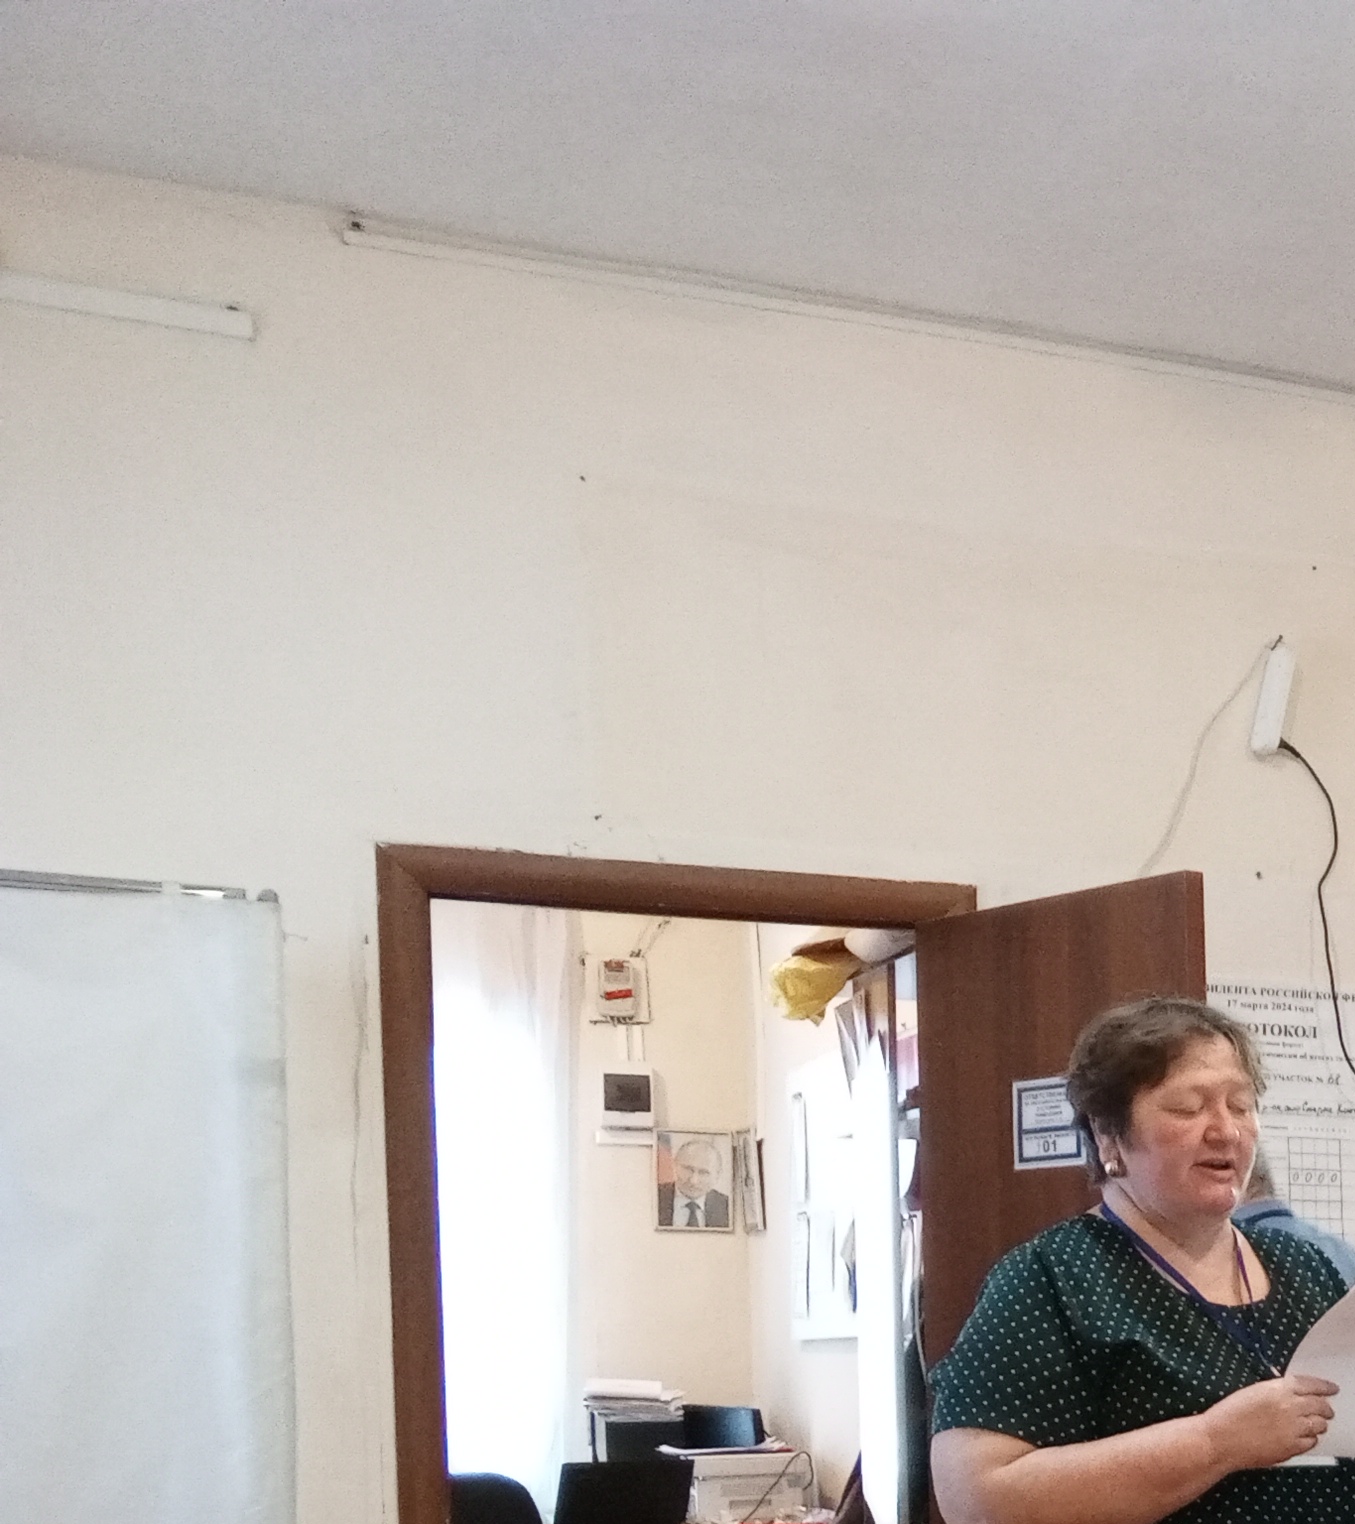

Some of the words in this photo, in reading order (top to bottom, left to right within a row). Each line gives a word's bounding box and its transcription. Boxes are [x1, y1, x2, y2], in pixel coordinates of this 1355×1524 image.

[1206, 984, 1257, 996] ИДЕНТА
[1271, 1002, 1292, 1012] 2024
[1248, 1022, 1318, 1039] ОТОКОЛ
